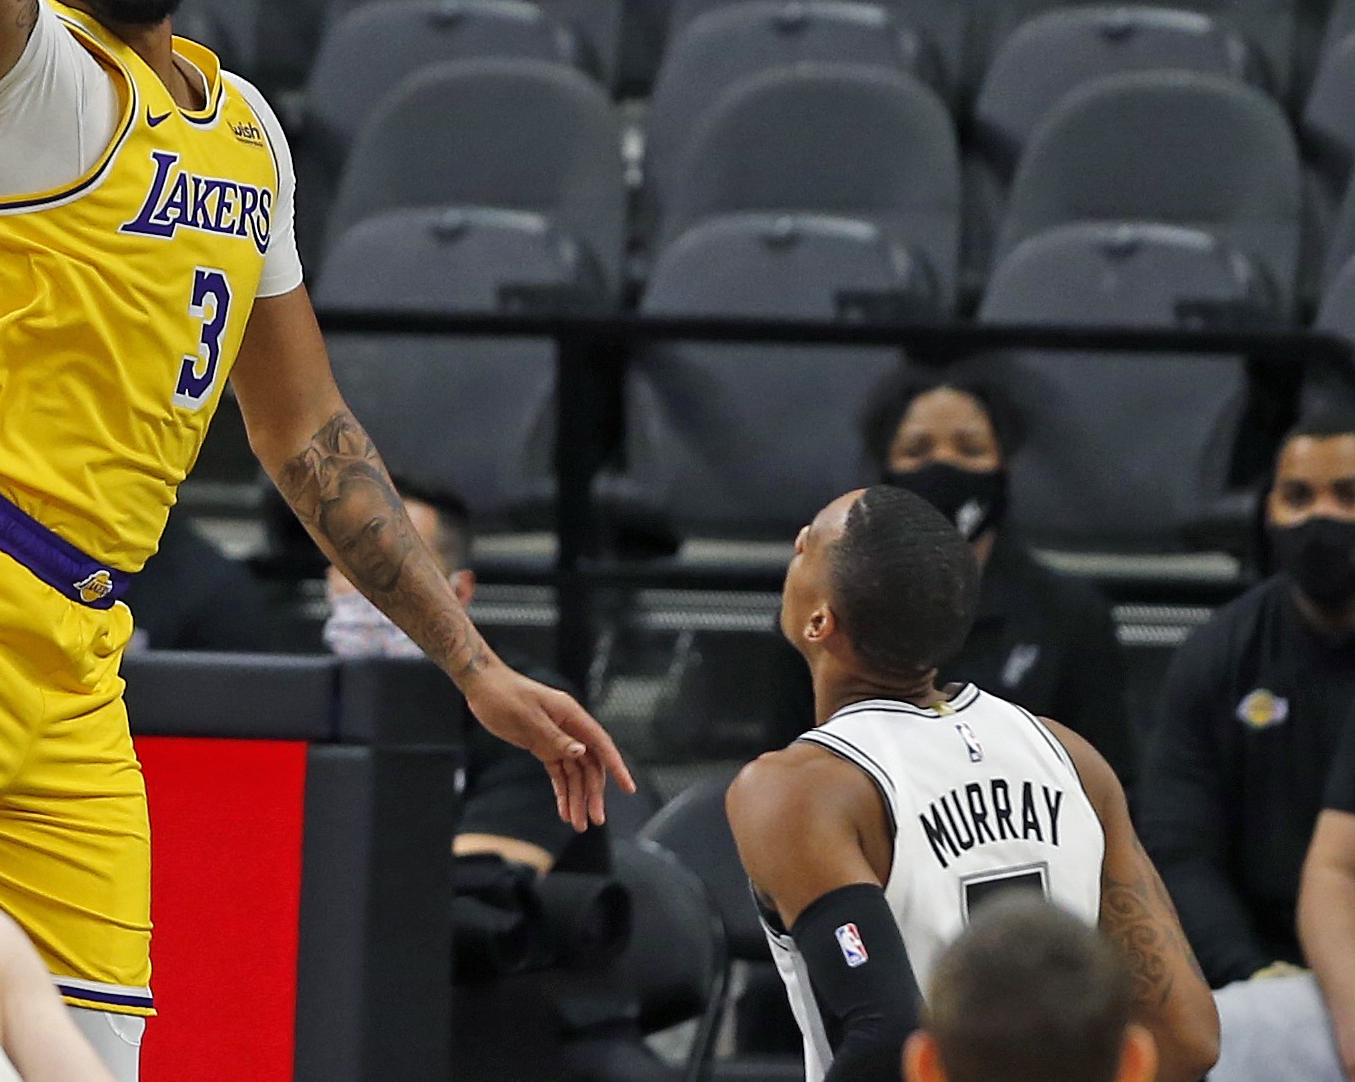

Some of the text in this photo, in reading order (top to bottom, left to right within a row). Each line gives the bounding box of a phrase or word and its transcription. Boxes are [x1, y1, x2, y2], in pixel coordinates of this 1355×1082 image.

[119, 149, 273, 256] LAKERS
[172, 265, 233, 409] 3
[919, 778, 1062, 869] MURRAY
